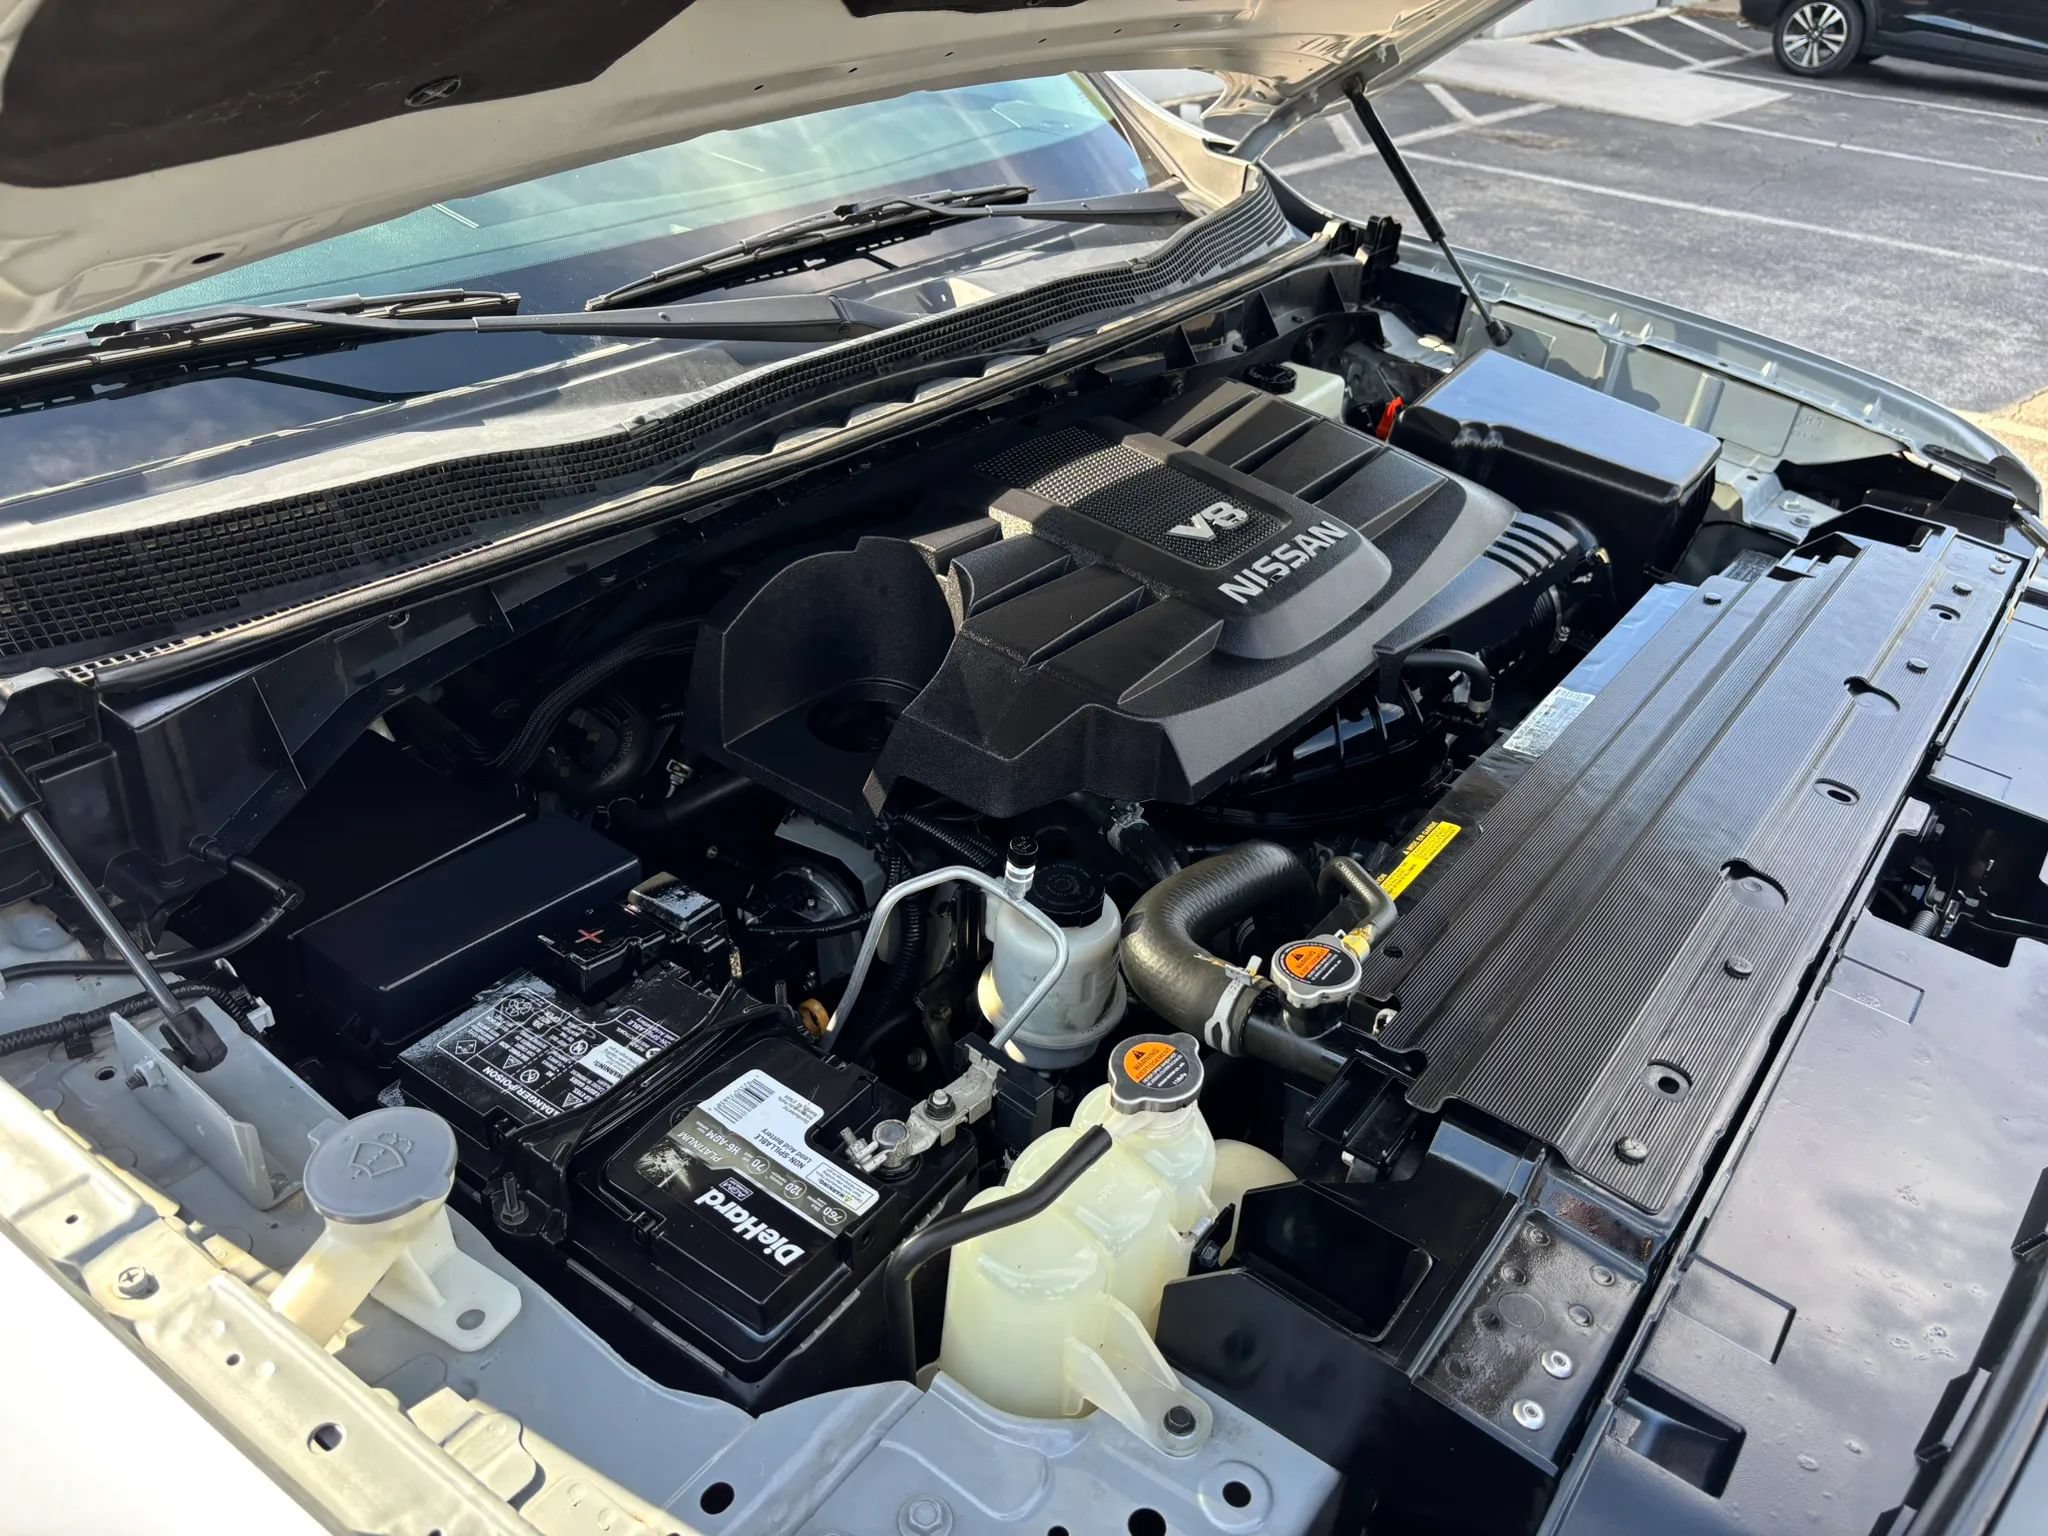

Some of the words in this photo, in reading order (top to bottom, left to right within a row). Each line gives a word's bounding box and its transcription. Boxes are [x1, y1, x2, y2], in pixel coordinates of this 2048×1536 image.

[1167, 501, 1249, 542] V8
[1217, 520, 1349, 605] NISSAN
[1133, 1048, 1160, 1070] WARNING
[481, 1065, 556, 1113] DANGER/POISON
[677, 1131, 723, 1161] PLATINUM
[705, 1129, 741, 1155] H6-AGM
[759, 1127, 785, 1145] Battery
[753, 1133, 805, 1169] NON-SPILLABLE
[781, 1142, 797, 1153] Acid
[794, 1151, 811, 1163] Lead
[749, 1158, 766, 1171] 70
[722, 1181, 746, 1198] AGM
[784, 1182, 803, 1195] 120
[816, 1178, 845, 1198] WARNING:
[821, 1206, 843, 1222] 760
[694, 1187, 805, 1266] DieHard
